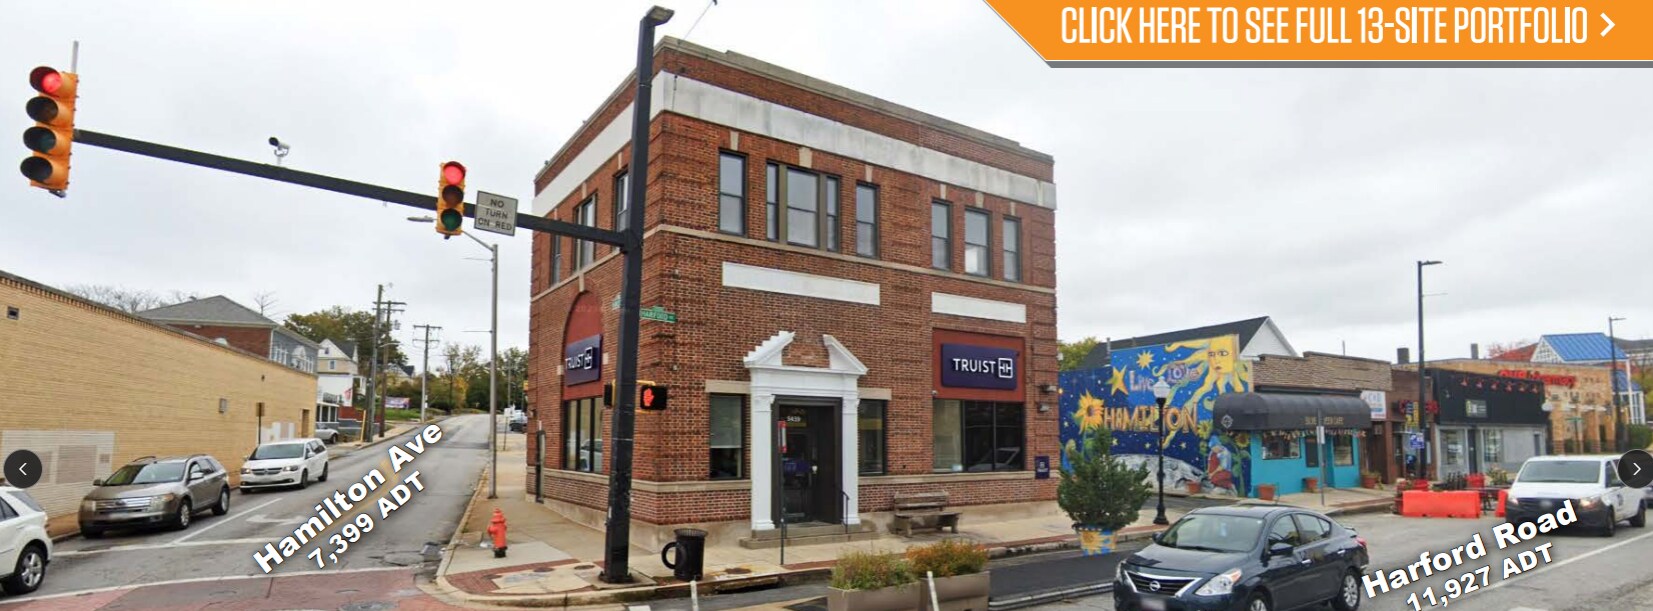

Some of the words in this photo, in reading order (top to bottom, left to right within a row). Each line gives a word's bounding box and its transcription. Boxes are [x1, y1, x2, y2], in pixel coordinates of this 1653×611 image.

[490, 199, 505, 209] NO
[486, 207, 509, 220] TURN
[477, 217, 490, 227] ON
[494, 220, 513, 231] RED
[953, 357, 997, 374] TRUIST
